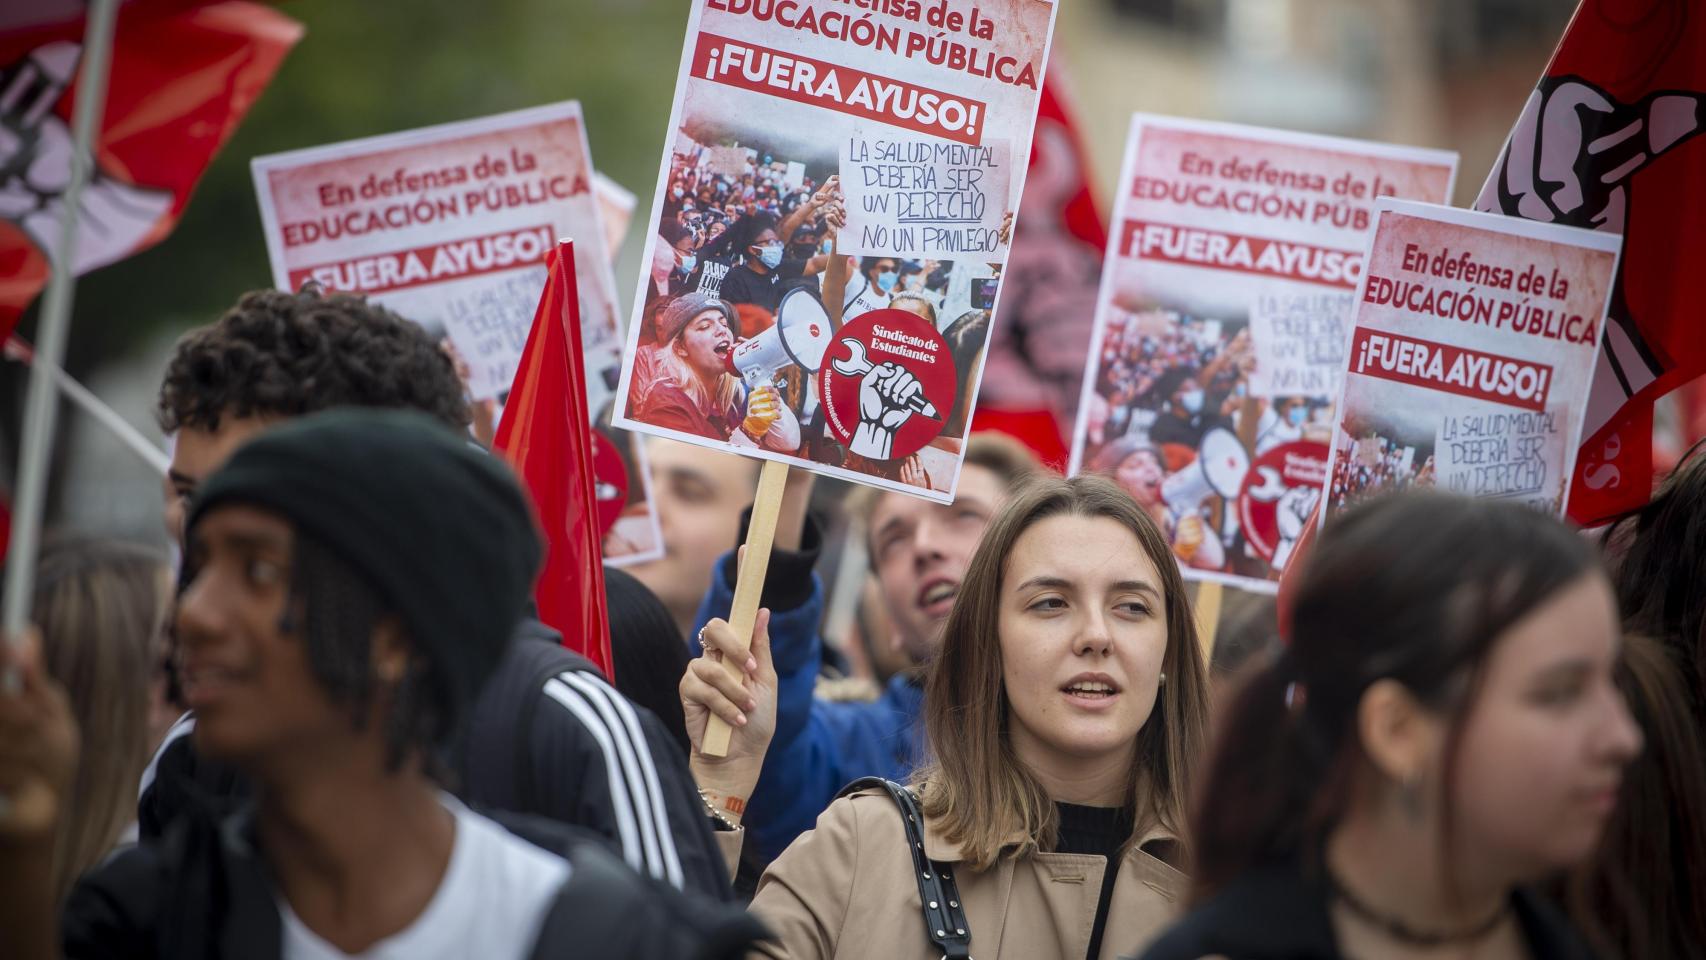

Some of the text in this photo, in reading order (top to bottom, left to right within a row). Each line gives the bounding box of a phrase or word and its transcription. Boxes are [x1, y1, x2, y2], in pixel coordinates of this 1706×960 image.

[926, 0, 964, 32] de
[968, 8, 994, 40] la
[906, 32, 1037, 90] PÚBLICA
[706, 43, 978, 135] ¡FUERA AYUSO!
[318, 147, 537, 208] En defensa de la
[850, 138, 998, 167] LA SALUD MENTAL
[1179, 152, 1214, 177] En
[1219, 157, 1326, 194] defensa
[1332, 171, 1366, 200] de
[861, 164, 984, 193] DEBERÍA SER
[1131, 176, 1369, 231] EDUCACIÓN PÚB
[280, 174, 591, 248] EDUCACIÓN PÚBLICA
[863, 192, 986, 220] UN DERECHO
[862, 225, 999, 252] NO UN PRIVILEGIO
[1130, 224, 1363, 283] ¡FUERA AYUSO
[1402, 243, 1569, 301] En defensa de la
[1362, 275, 1495, 325] EDUCACIÓN
[1495, 298, 1596, 347] PÚBLICA
[870, 338, 936, 363] Estudiantes
[872, 324, 939, 351] Sindicato de
[1357, 335, 1443, 386] ¡FUERA
[1444, 354, 1549, 403] AYUSO!
[1461, 414, 1507, 437] SALUD
